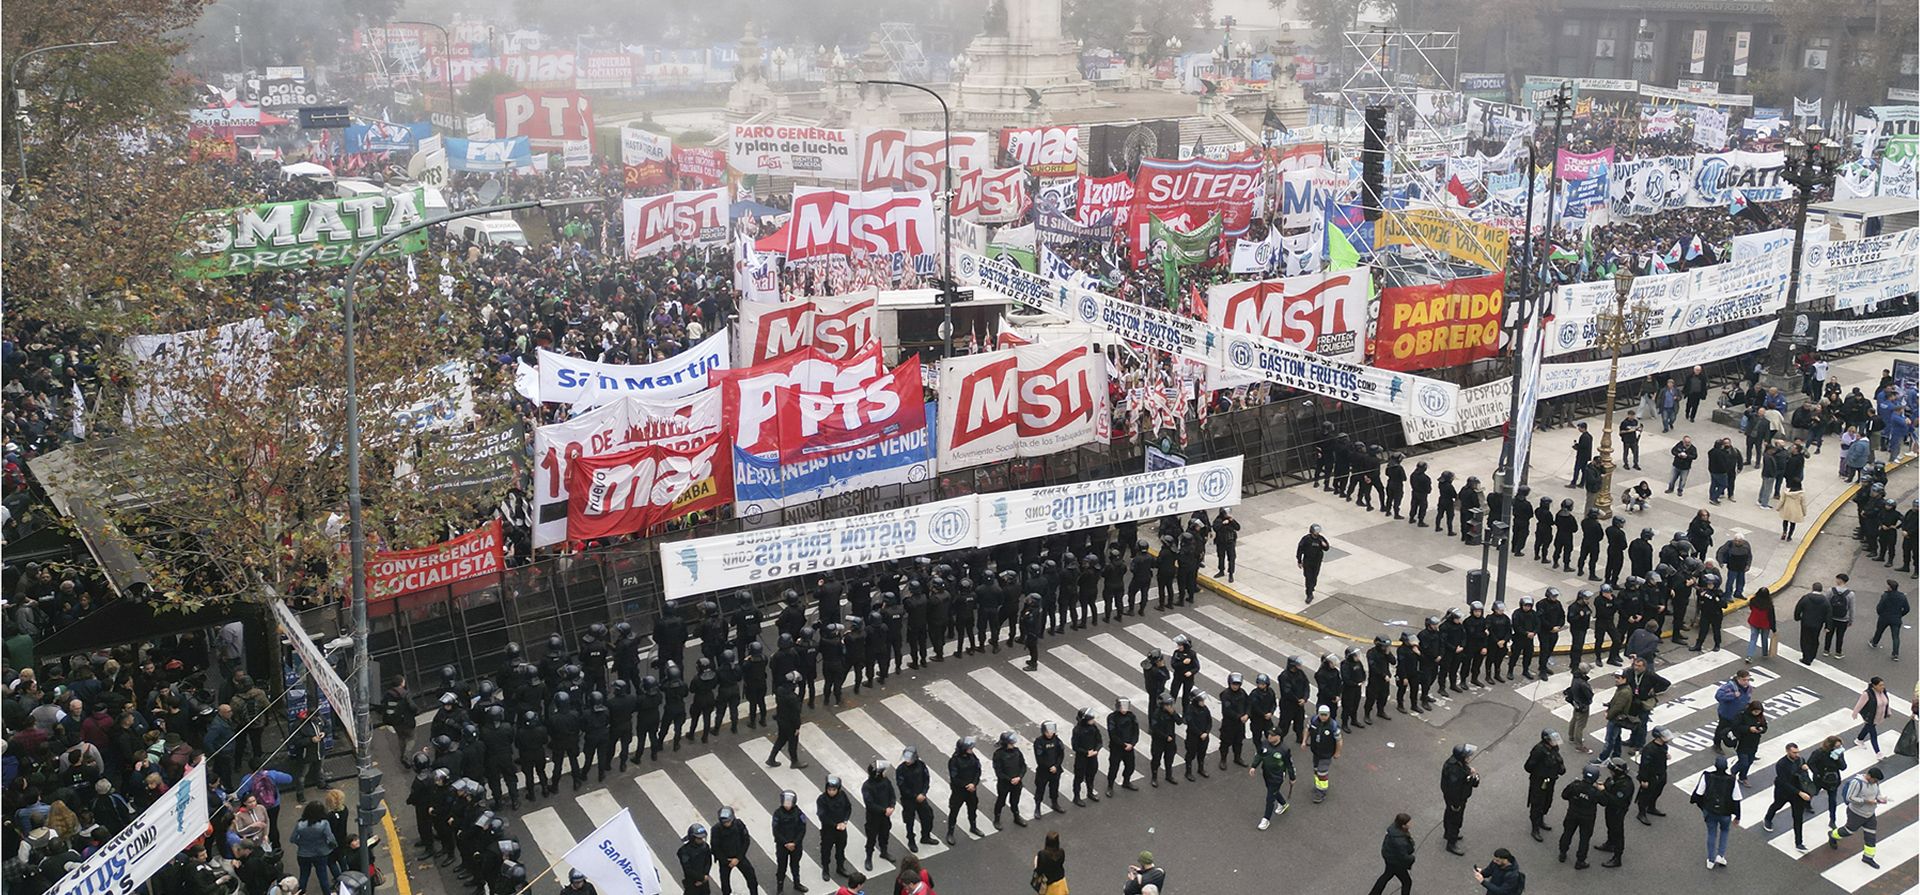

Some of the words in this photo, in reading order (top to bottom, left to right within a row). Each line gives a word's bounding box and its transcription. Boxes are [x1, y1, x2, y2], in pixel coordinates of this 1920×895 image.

[261, 94, 318, 107] OBRERO
[268, 83, 306, 96] POLO
[504, 94, 590, 138] PTS
[734, 140, 743, 156] y
[745, 139, 779, 156] plan
[780, 141, 800, 153] de
[803, 140, 849, 156] lucha
[735, 126, 775, 139] PARO
[777, 127, 846, 143] GENERAL
[645, 198, 722, 241] MST
[796, 199, 918, 257] MST
[979, 278, 1045, 308] PANADEROS
[1104, 298, 1114, 310] LA
[1393, 289, 1502, 330] PARTIDO
[1102, 307, 1140, 333] GASTON
[1142, 319, 1181, 346] FRUTOS
[1106, 324, 1184, 355] PANADEROS
[1317, 332, 1345, 346] FRENTE
[1393, 319, 1499, 360] OBRERO
[557, 367, 619, 391] San
[624, 350, 721, 392] Martín
[1259, 352, 1307, 380] GASTON
[1309, 363, 1358, 392] FRUTOS
[1265, 370, 1360, 402] PANADEROS
[799, 373, 902, 438] PTS
[966, 358, 1090, 431] MST
[591, 429, 613, 455] DE
[855, 445, 879, 461] SE
[880, 430, 929, 456] VENDE
[952, 447, 993, 461] Movimiento
[1029, 439, 1040, 448] de
[1042, 435, 1054, 445] los
[1418, 430, 1436, 443] QUE
[590, 471, 606, 513] nuevo
[603, 442, 720, 513] mas
[372, 534, 496, 578] CONVERGENCIA
[372, 550, 498, 599] SOCIALISTA
[598, 838, 621, 864] San
